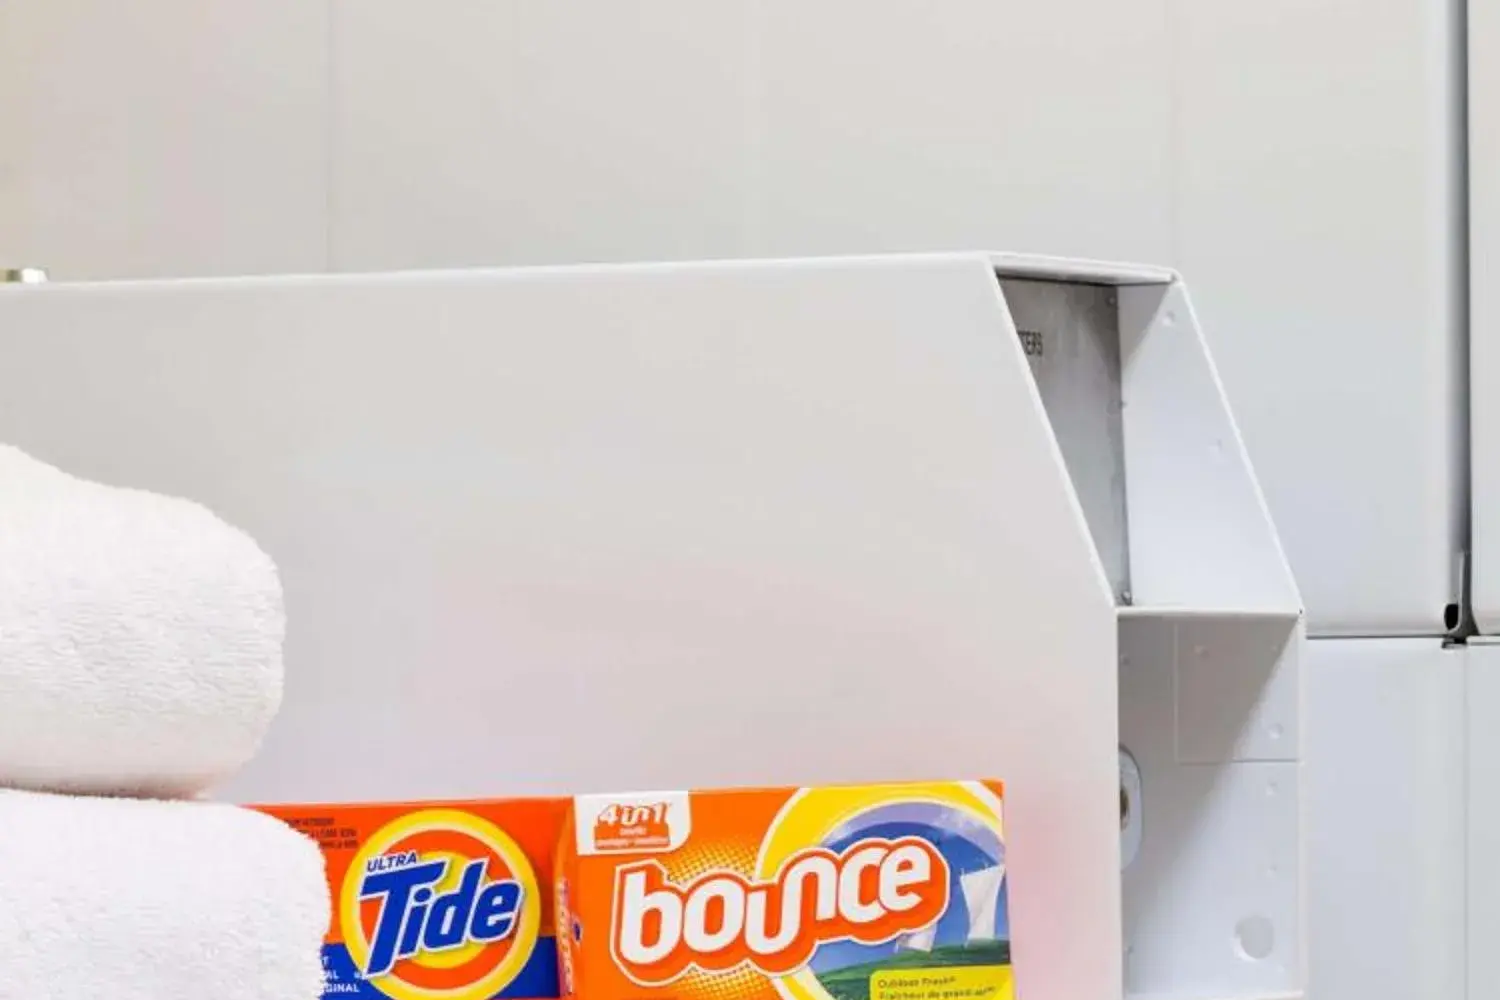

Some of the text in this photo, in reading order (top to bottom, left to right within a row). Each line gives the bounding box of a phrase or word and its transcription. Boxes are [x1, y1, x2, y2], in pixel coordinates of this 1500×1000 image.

[367, 852, 417, 872] ULTRA
[359, 858, 522, 978] Tide
[618, 844, 931, 965] bounce
[324, 983, 361, 997] GINAL
